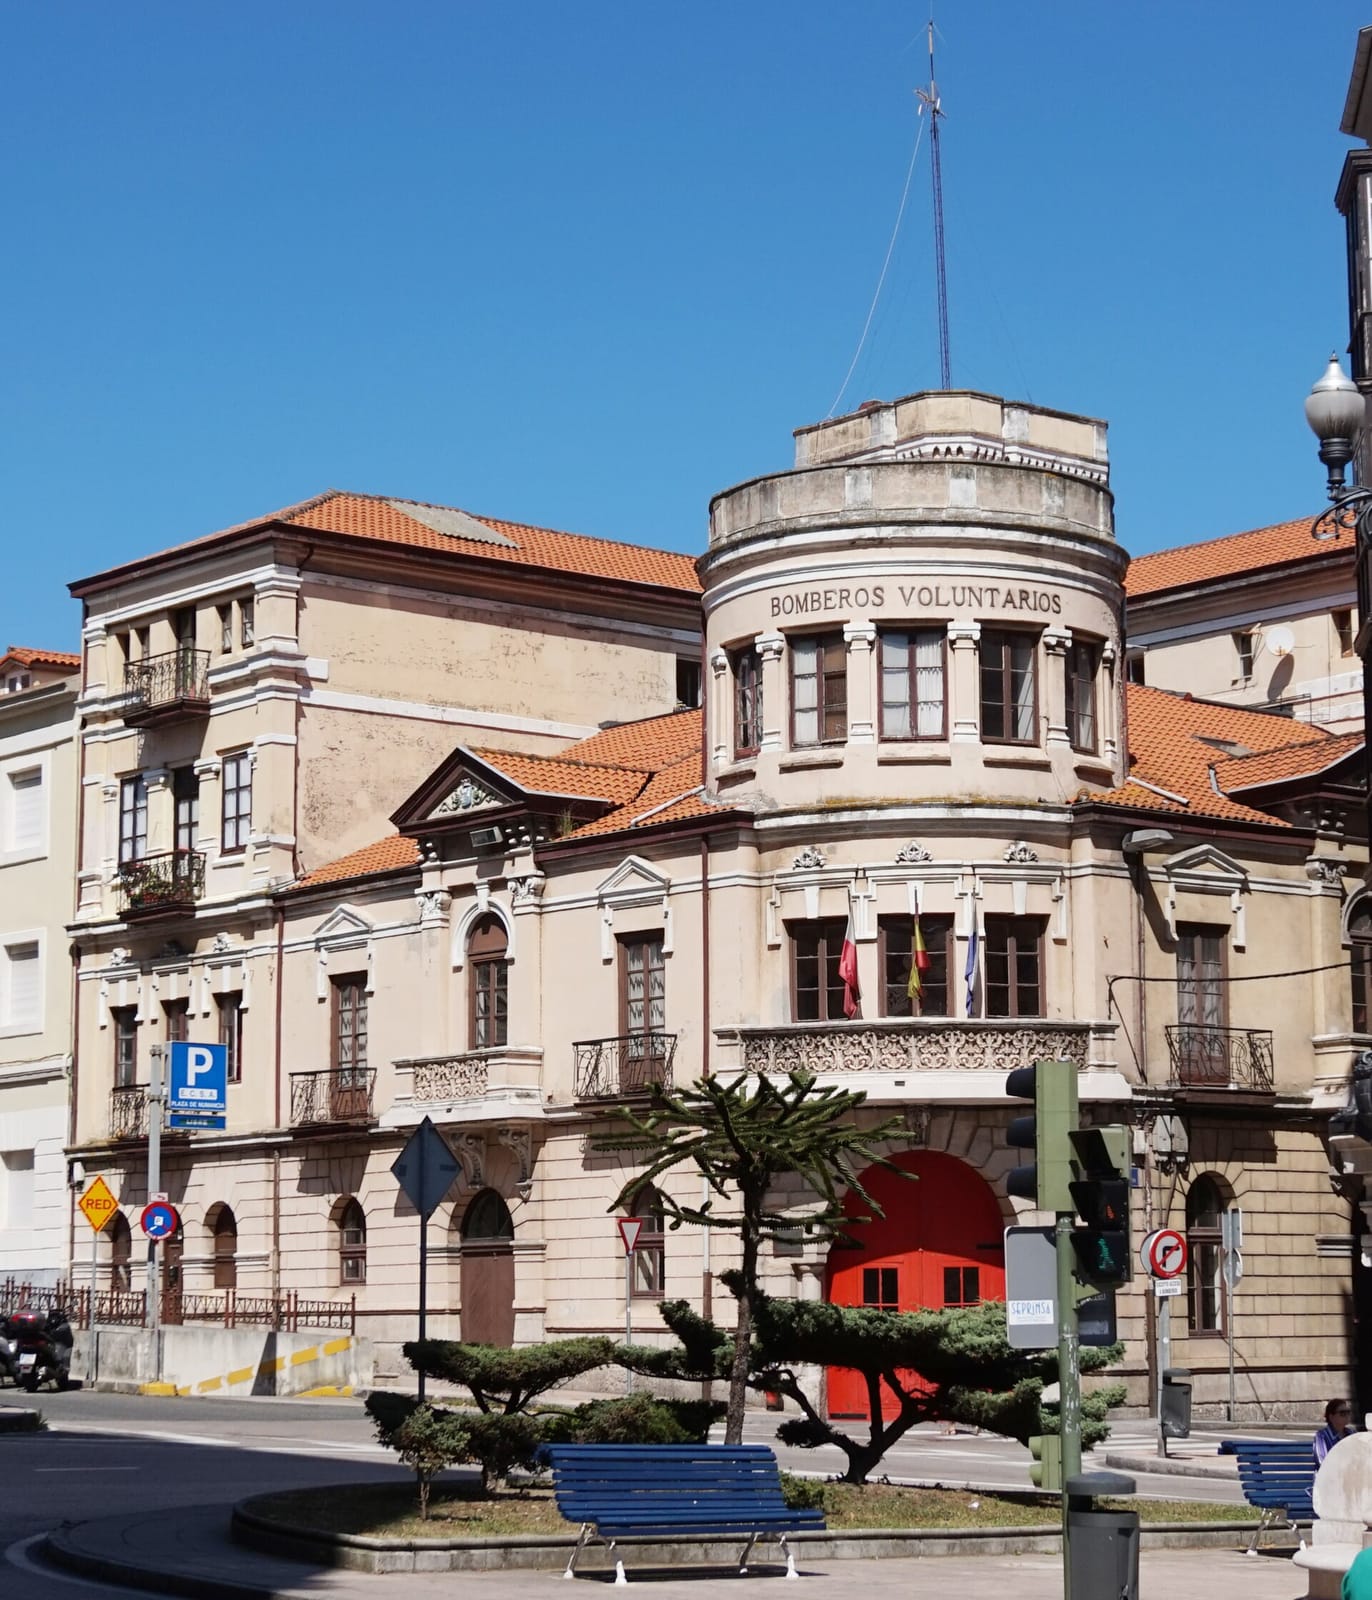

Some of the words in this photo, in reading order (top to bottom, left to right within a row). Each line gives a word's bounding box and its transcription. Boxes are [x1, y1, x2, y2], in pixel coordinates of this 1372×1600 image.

[771, 587, 884, 617] BOMBEROS
[898, 586, 1062, 615] VOLUNTARIOS
[187, 1046, 213, 1086] P
[86, 1199, 112, 1210] RED
